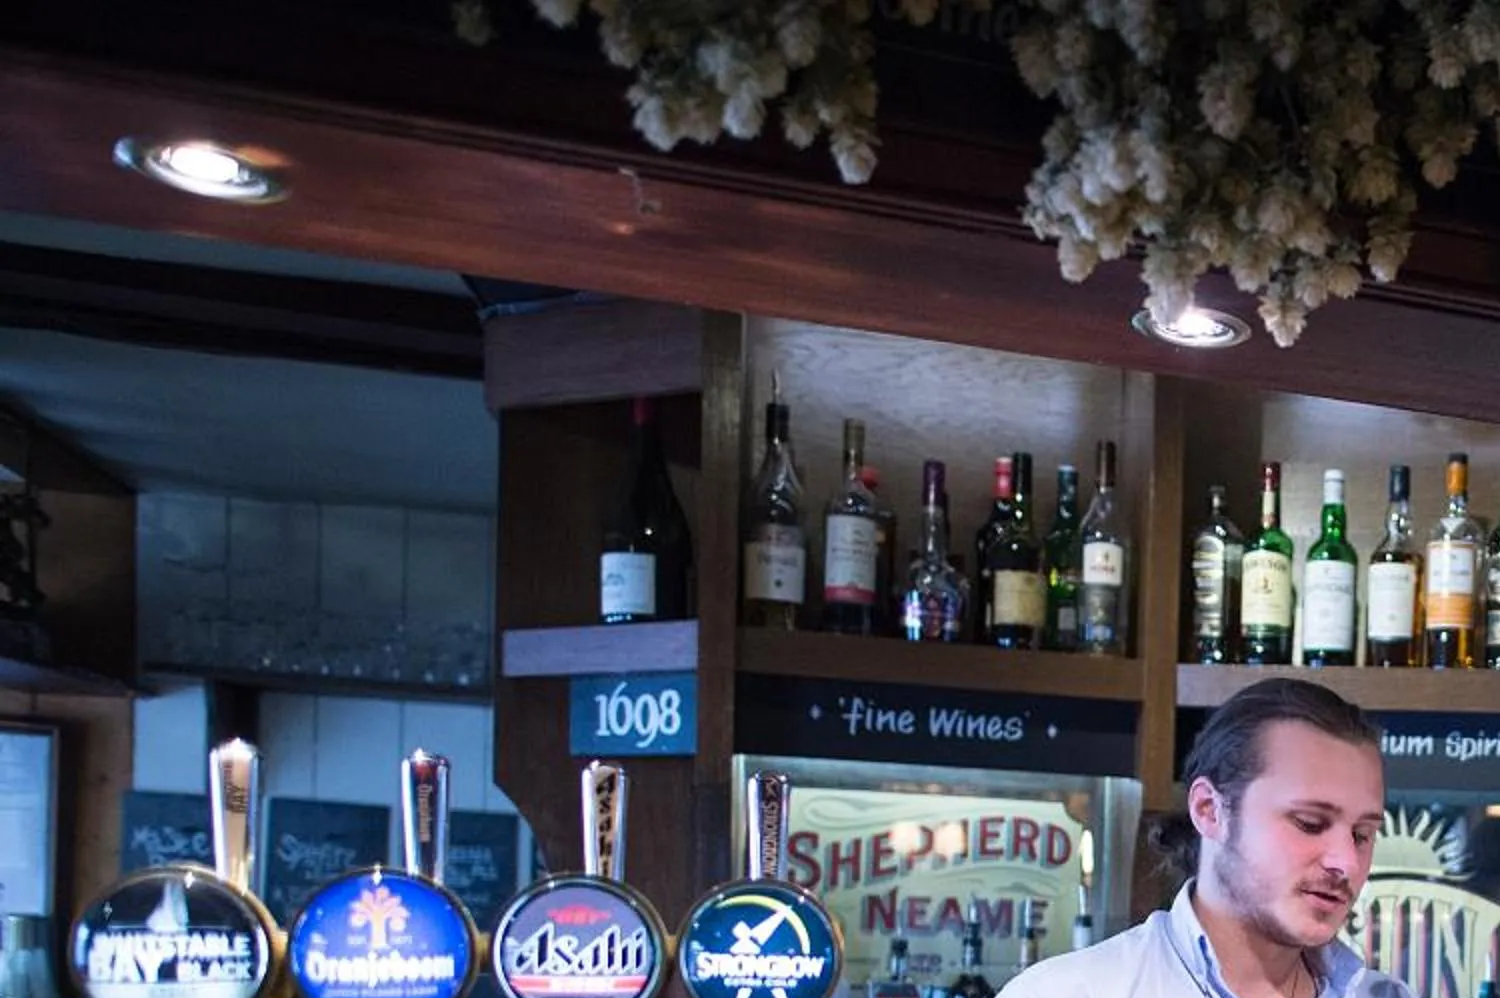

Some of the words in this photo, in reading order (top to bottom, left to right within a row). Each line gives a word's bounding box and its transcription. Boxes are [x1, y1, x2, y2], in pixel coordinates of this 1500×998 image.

[594, 681, 682, 748] 1698
[862, 887, 1049, 939] NEAME
[88, 946, 168, 983] BAY
[505, 922, 648, 976] Asahi
[697, 951, 826, 980] STRONGBOW
